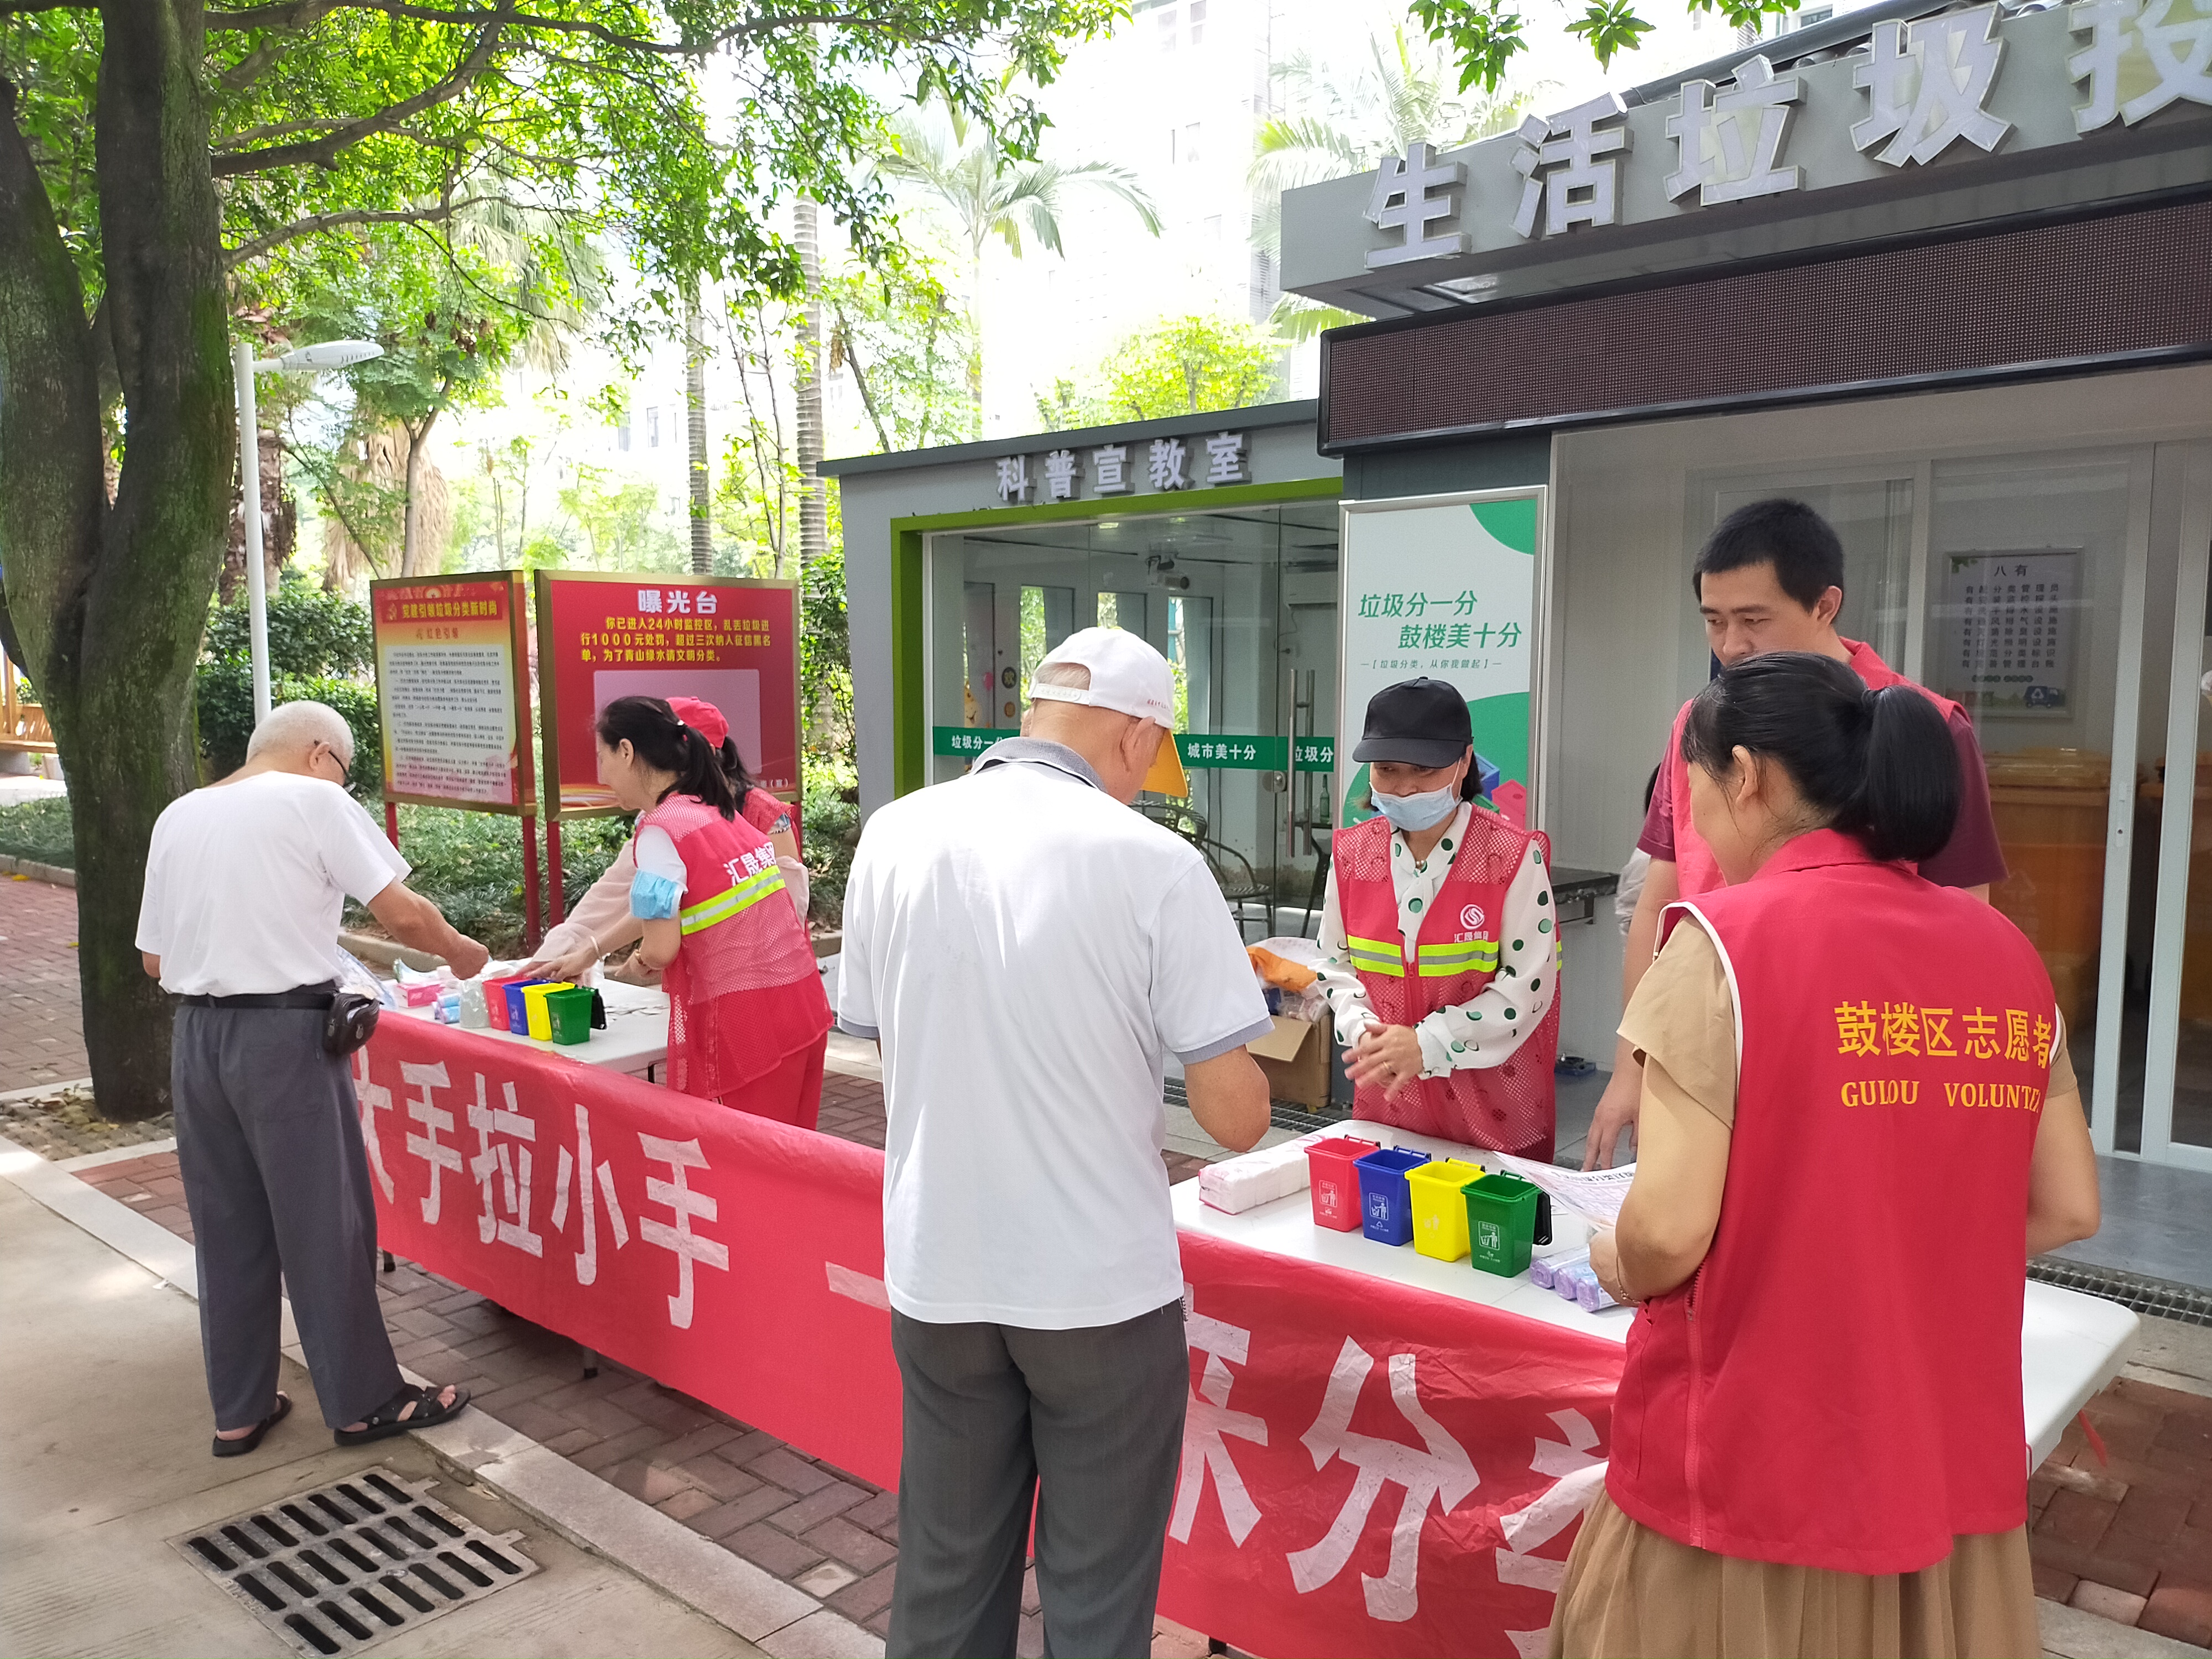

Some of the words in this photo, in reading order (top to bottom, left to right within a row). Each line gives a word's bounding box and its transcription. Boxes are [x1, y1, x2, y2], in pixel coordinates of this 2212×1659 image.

[1363, 0, 2212, 269] 生活垃圾投
[996, 432, 1250, 502] 科普宣教室
[638, 589, 718, 614] 曝光台
[1358, 590, 1478, 618] 垃圾分一分
[1397, 622, 1522, 649] 鼓楼美十分
[1187, 743, 1256, 761] 城市美十分
[1834, 1000, 2052, 1070] 鼓楼区志愿者
[1841, 1080, 1920, 1107] GULOU
